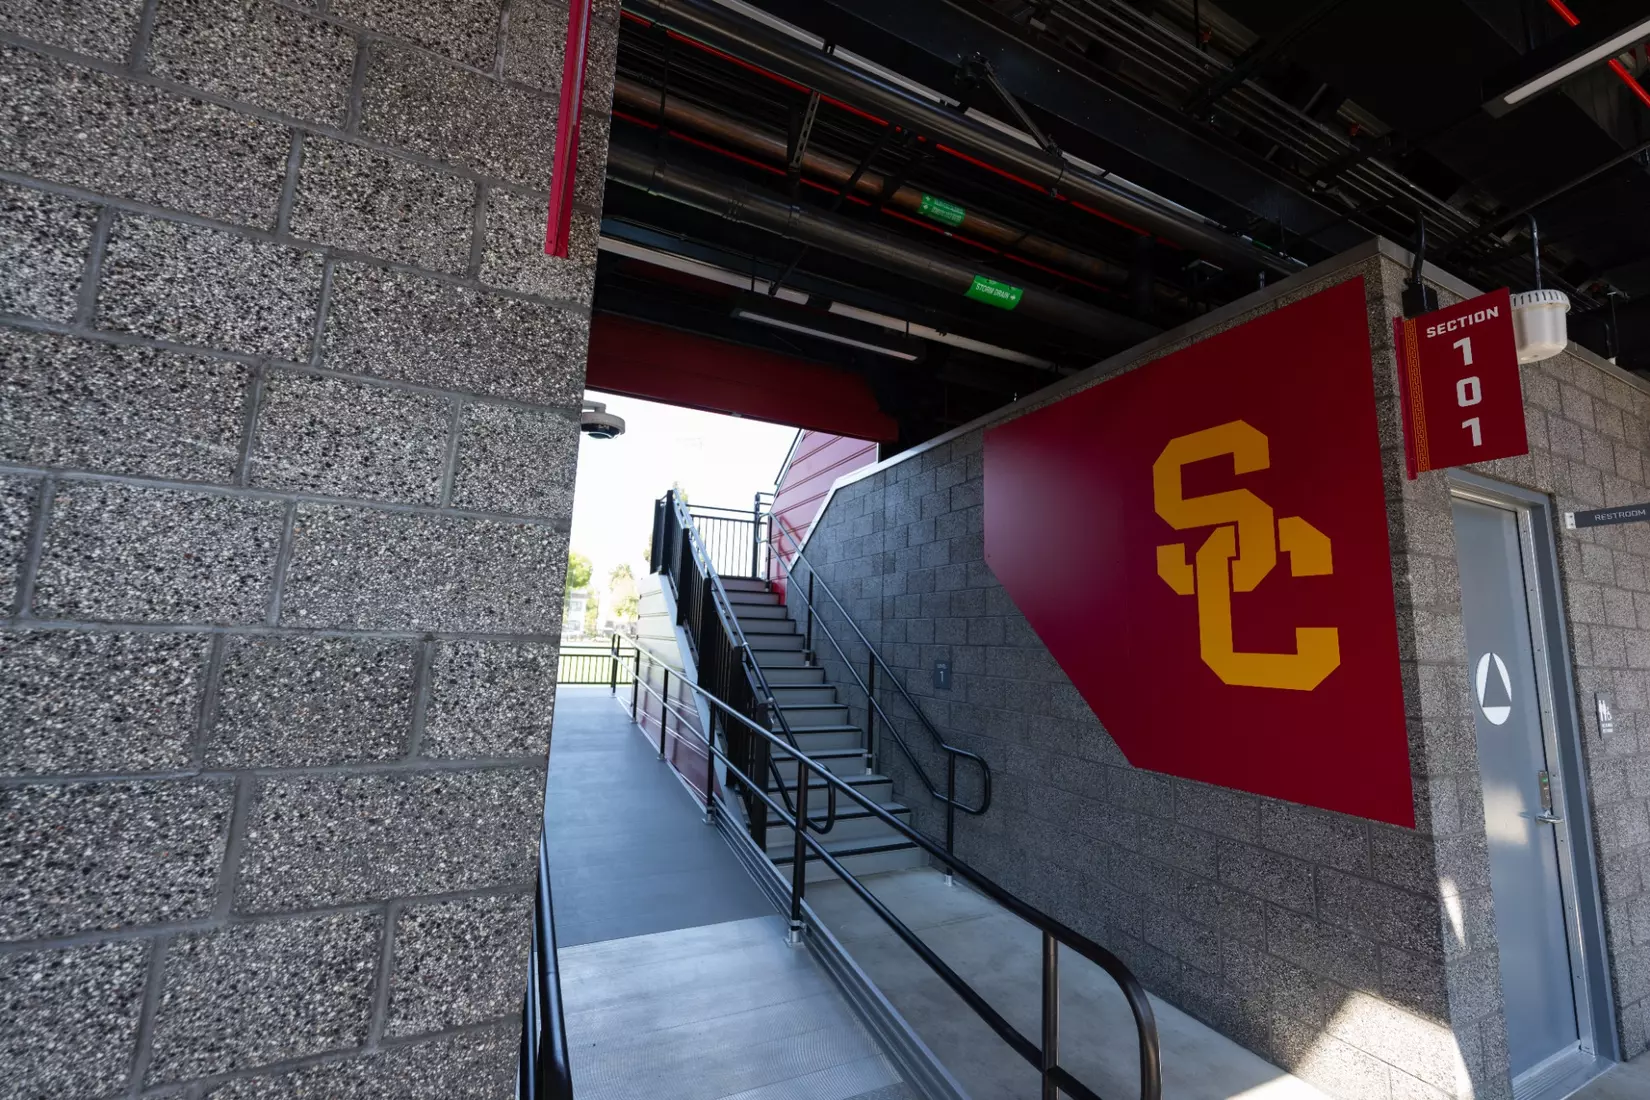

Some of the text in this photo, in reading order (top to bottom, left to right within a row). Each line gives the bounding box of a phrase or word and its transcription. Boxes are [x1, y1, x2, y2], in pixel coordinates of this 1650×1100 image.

[976, 283, 1010, 299] STORM DRAIN
[1426, 306, 1499, 338] SECTION
[1453, 337, 1482, 447] 101
[1594, 509, 1646, 521] RESTROOM
[1153, 419, 1341, 691] SC
